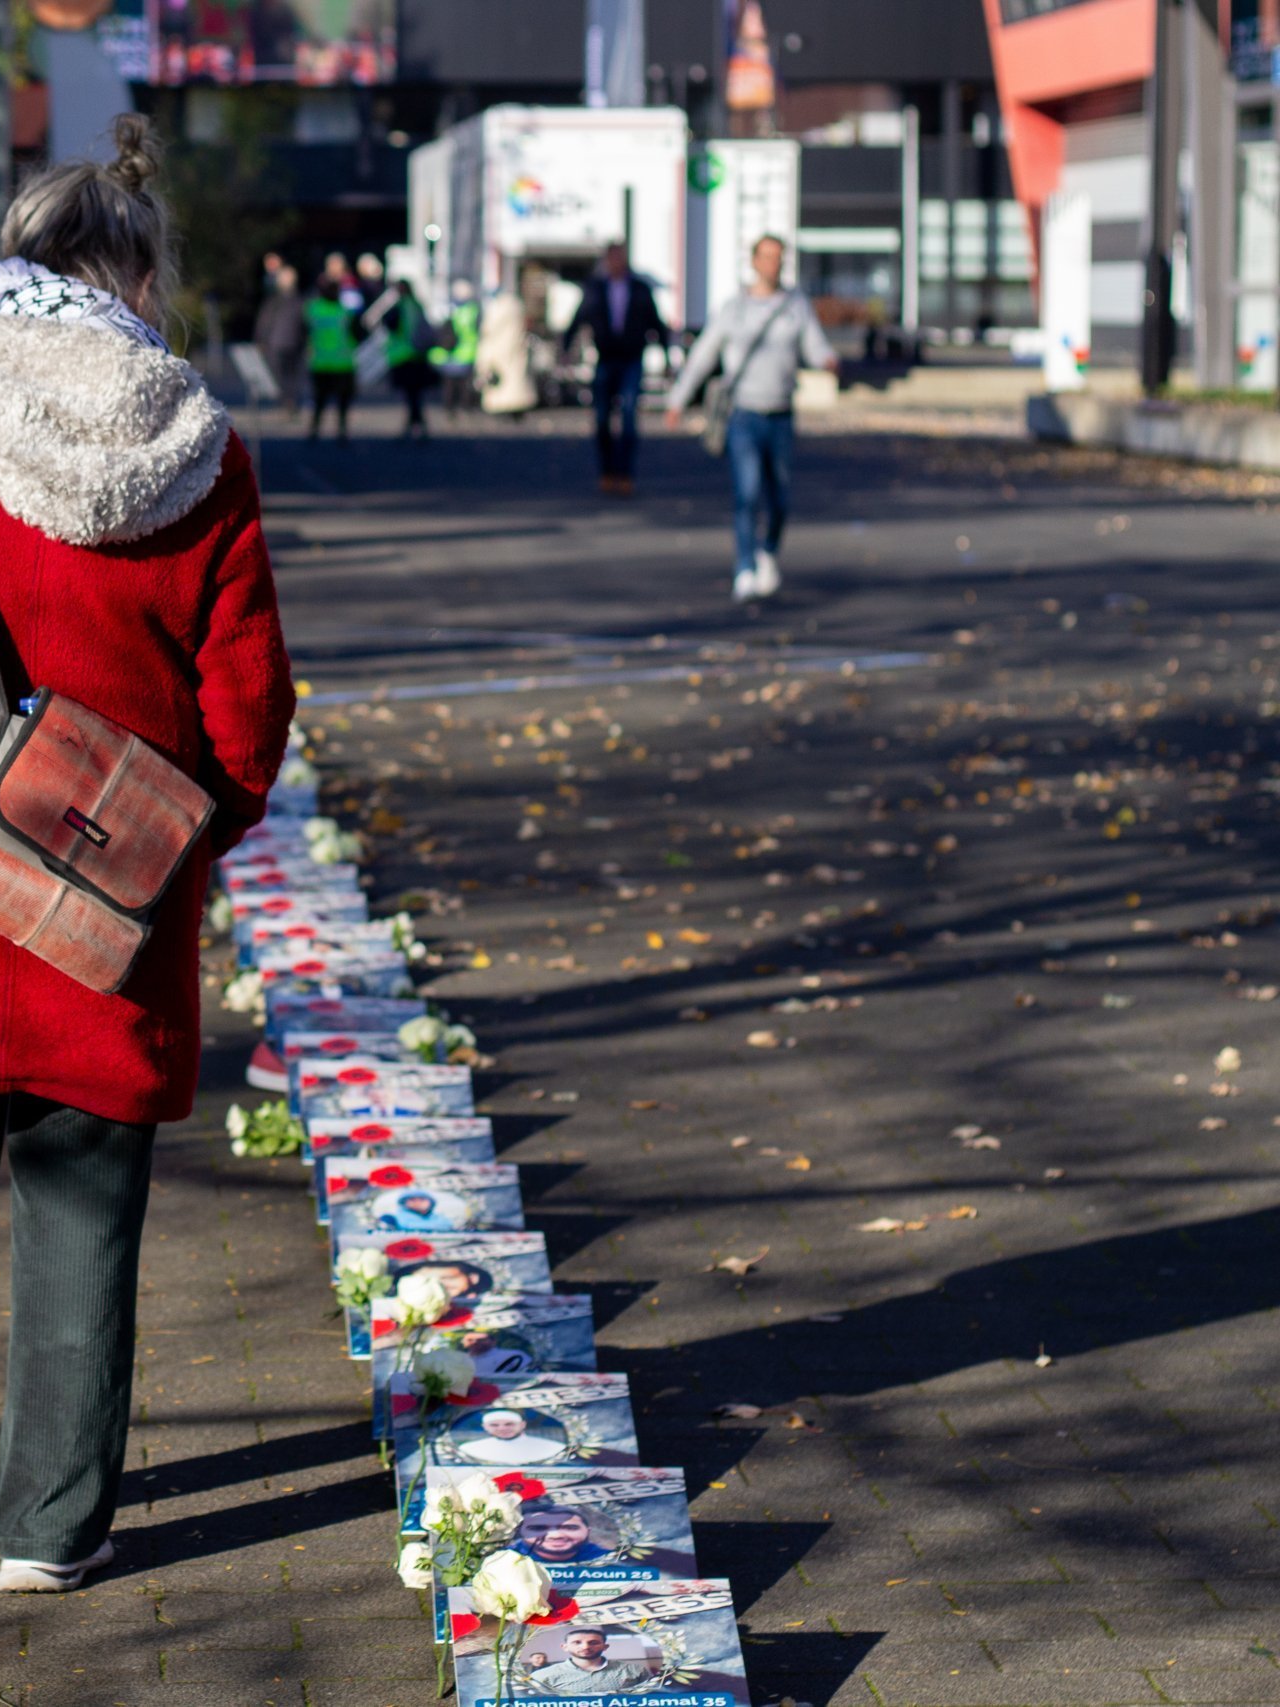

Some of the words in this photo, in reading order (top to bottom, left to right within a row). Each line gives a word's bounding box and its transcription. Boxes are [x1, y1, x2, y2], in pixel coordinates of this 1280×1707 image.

[551, 1479, 685, 1501] PRESS
[550, 1569, 574, 1579] bu
[578, 1570, 627, 1580] Aoun
[631, 1571, 653, 1580] 25
[582, 1591, 730, 1622] PRESS
[609, 1696, 698, 1707] Al-Jamal
[703, 1697, 727, 1707] 35
